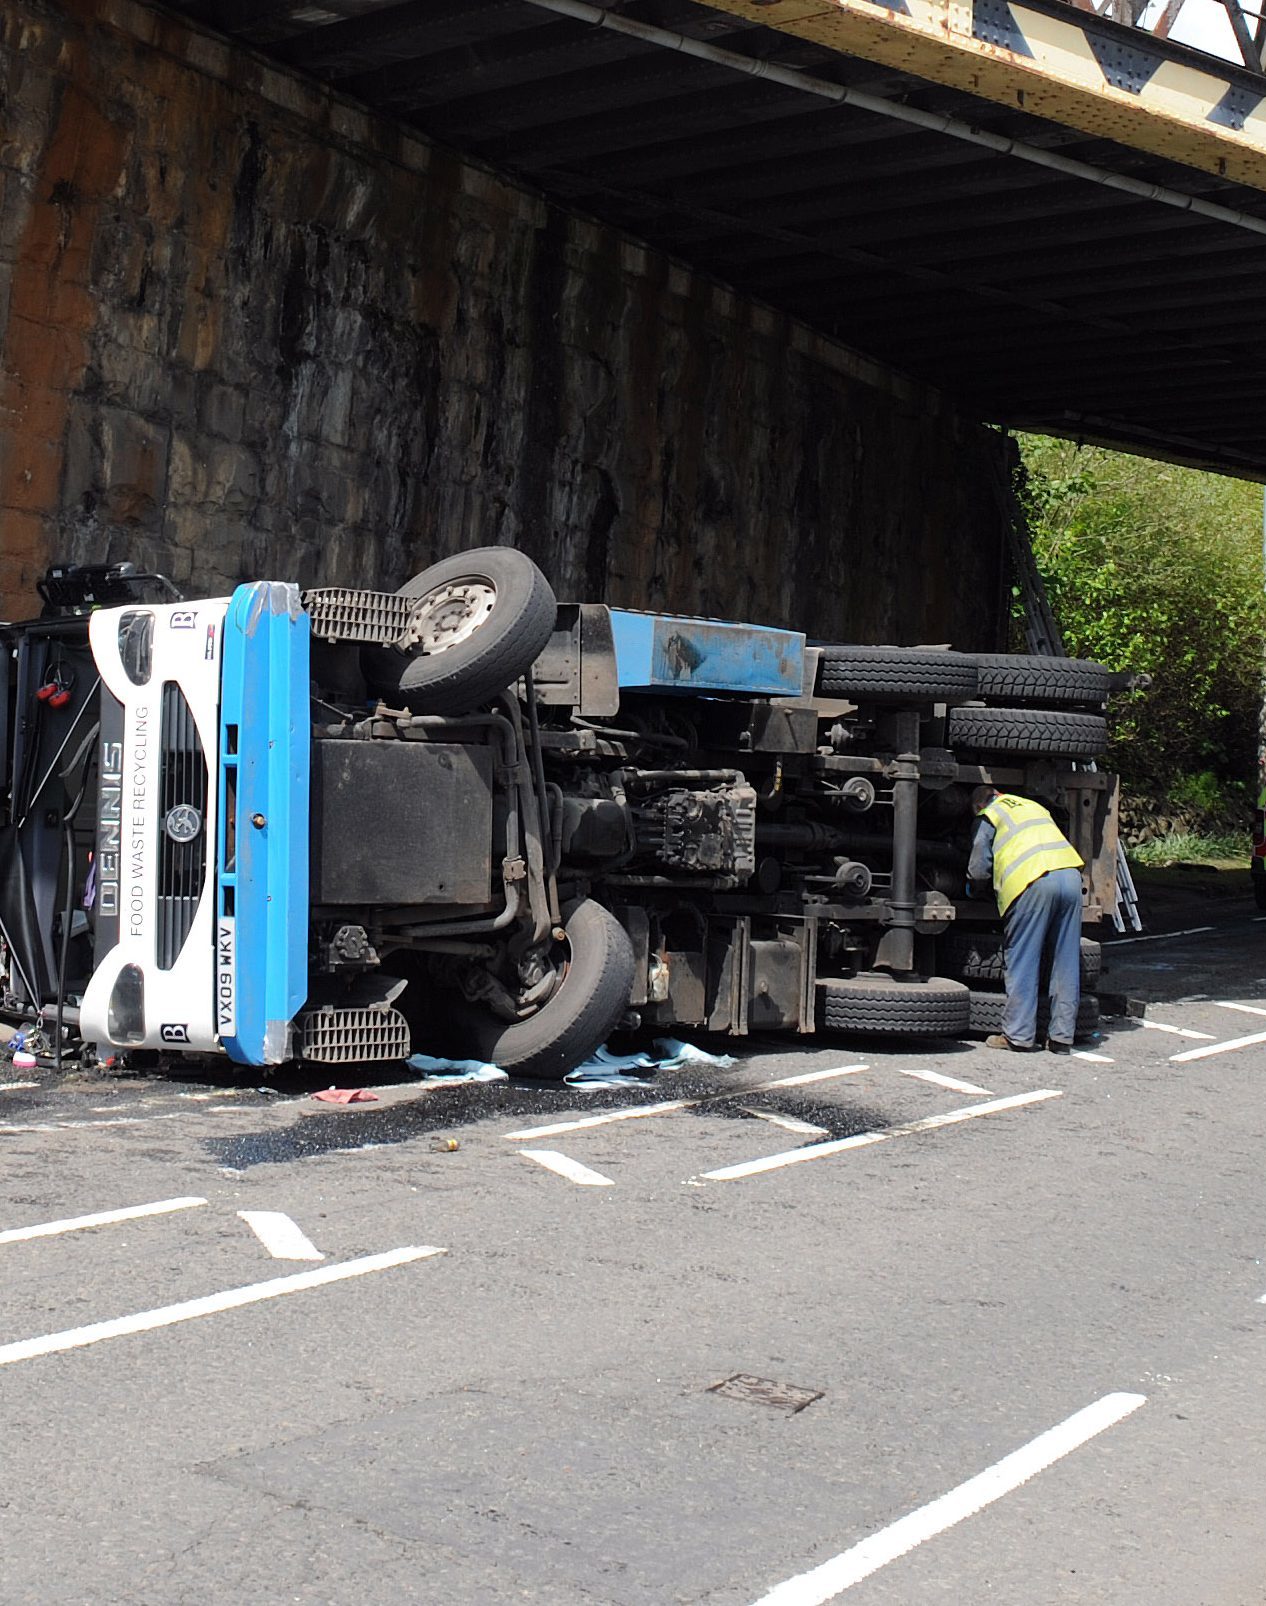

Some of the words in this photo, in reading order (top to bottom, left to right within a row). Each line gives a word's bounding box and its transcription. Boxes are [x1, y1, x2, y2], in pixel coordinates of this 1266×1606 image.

[132, 706, 148, 810] RECYCLING
[99, 742, 123, 917] DENNIS
[131, 816, 145, 879] WASTE
[130, 885, 144, 937] FOOD
[219, 927, 232, 966] WKV
[219, 973, 232, 1025] VX09
